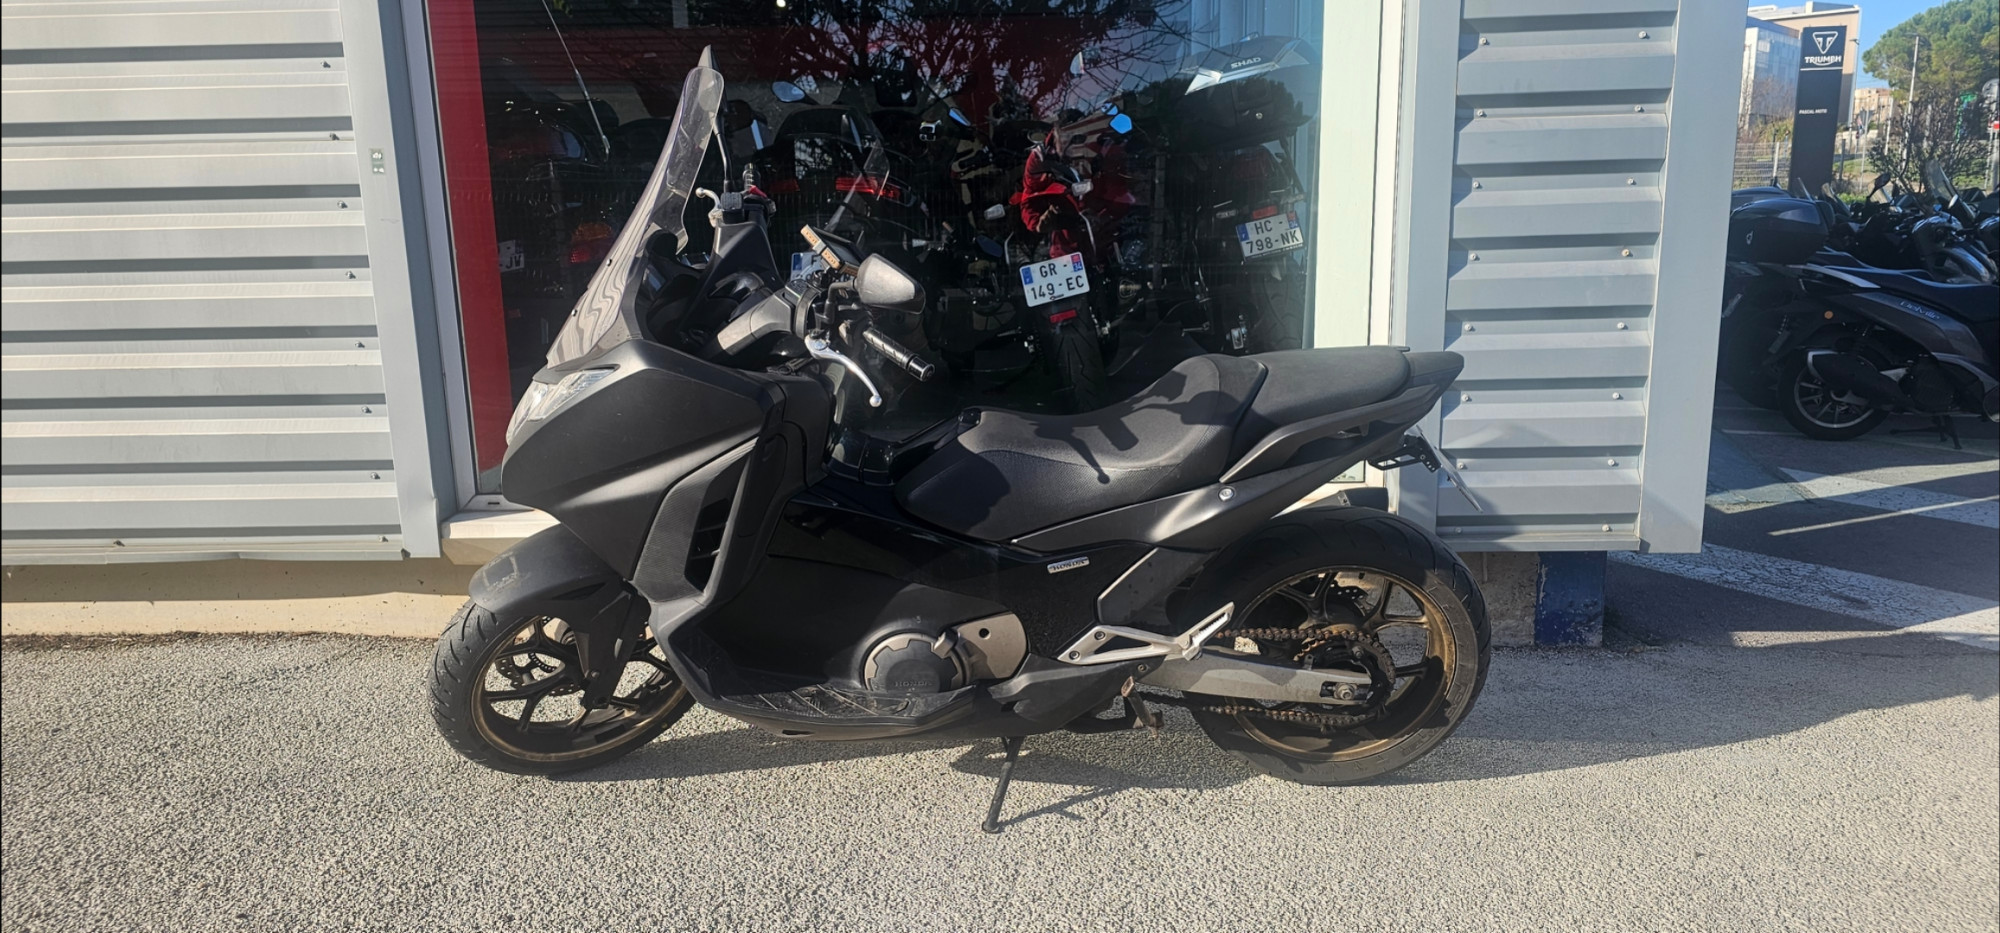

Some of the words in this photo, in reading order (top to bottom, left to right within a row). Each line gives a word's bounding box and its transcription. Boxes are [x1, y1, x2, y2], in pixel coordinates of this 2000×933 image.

[1231, 57, 1261, 69] SHAD
[1804, 55, 1842, 66] TRIUMPH
[1254, 220, 1272, 235] HC
[1039, 263, 1057, 278] GR
[1051, 559, 1087, 571] HONDA
